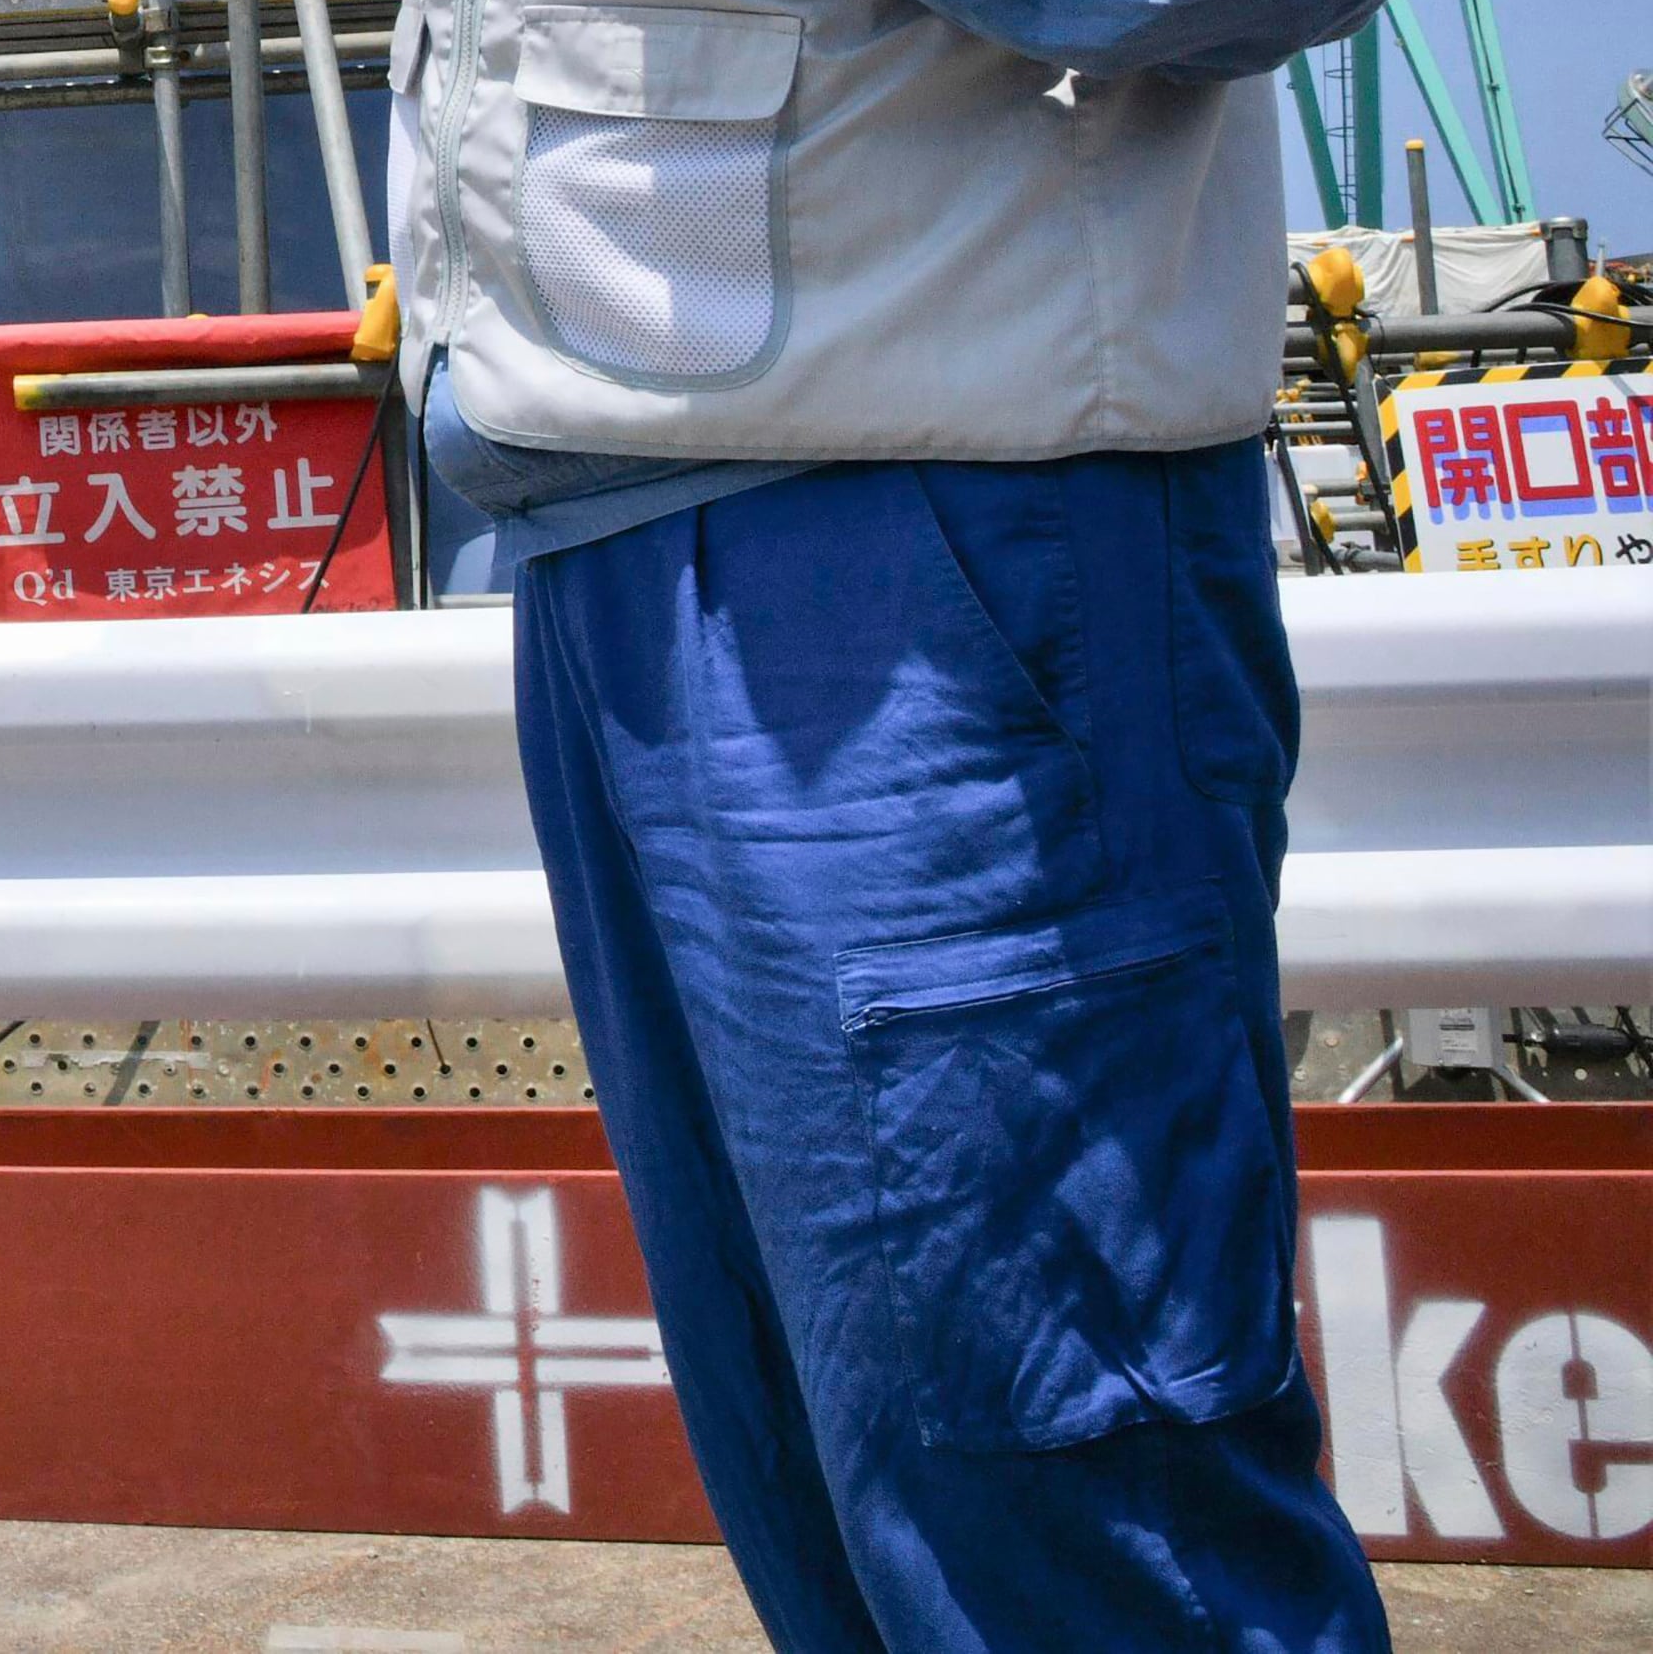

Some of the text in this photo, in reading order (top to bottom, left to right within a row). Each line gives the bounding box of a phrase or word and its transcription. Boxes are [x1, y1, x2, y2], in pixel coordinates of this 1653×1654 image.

[39, 401, 279, 458] 関係者以外
[105, 559, 331, 604] 東京エネシス
[1295, 1213, 1653, 1541] ke
